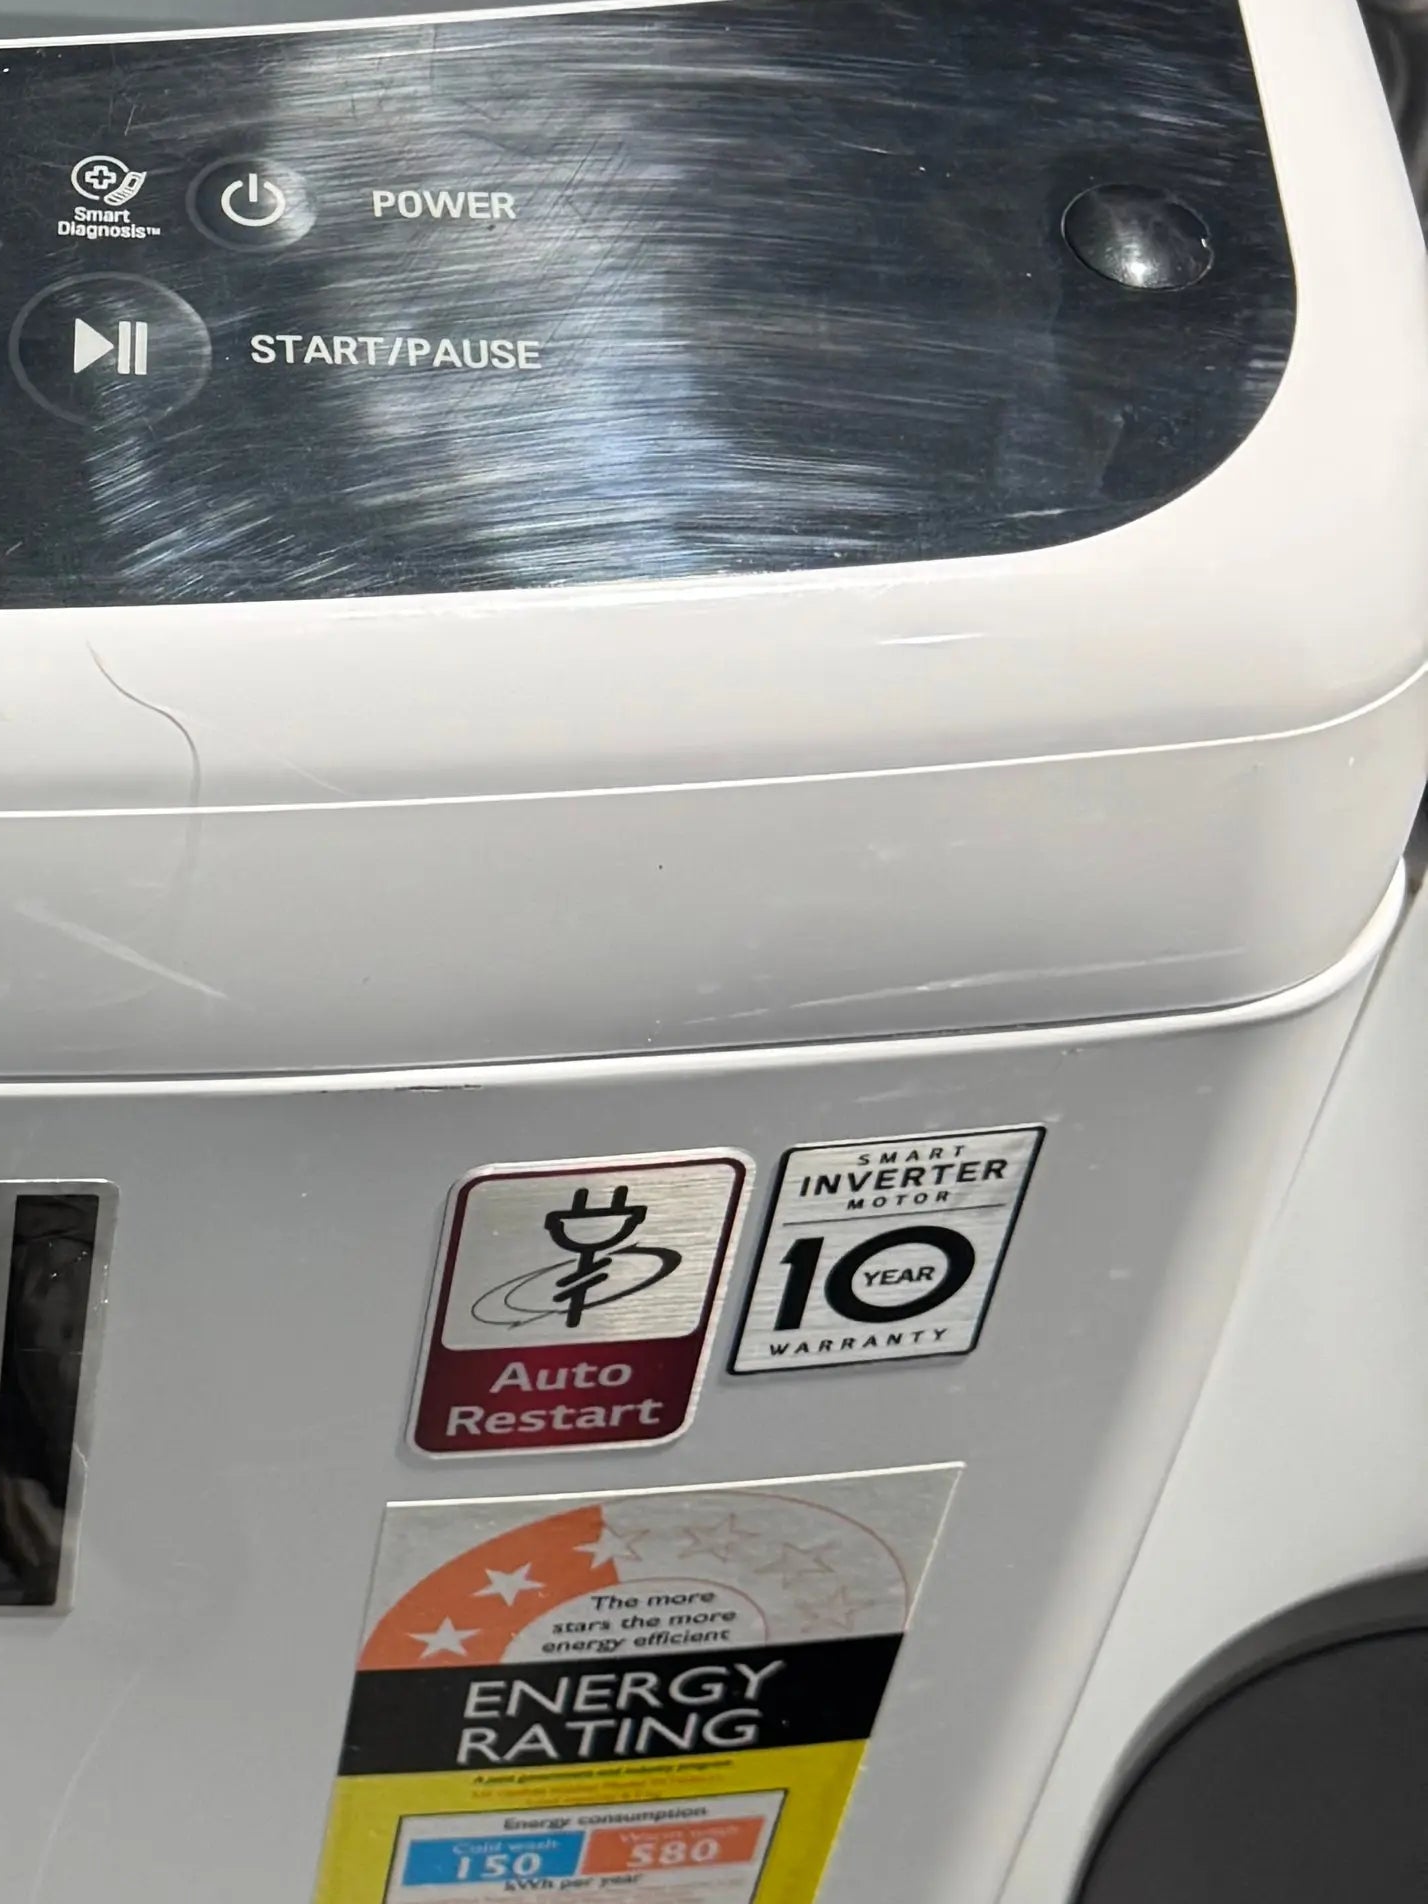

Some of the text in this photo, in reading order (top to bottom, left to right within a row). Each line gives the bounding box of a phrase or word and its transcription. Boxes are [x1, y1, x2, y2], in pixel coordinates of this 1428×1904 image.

[73, 206, 131, 224] Smart
[372, 189, 517, 219] POWER
[250, 334, 543, 370] START/PAUSE
[857, 1145, 966, 1167] SMART
[799, 1158, 1009, 1197] INVERTER
[846, 1190, 951, 1211] MOTOR
[773, 1225, 976, 1331] 10
[862, 1265, 937, 1287] YEAR
[769, 1327, 949, 1357] WARRANTY
[489, 1358, 634, 1395] Auto
[445, 1394, 664, 1437] Restart
[590, 1590, 717, 1612] The more
[552, 1609, 737, 1635] stars the more
[541, 1627, 731, 1655] energy efficient
[463, 1658, 786, 1720] ENERGY
[456, 1707, 764, 1765] RATING
[504, 1805, 708, 1832] Energy consumption
[455, 1851, 542, 1880] 150
[626, 1838, 721, 1869] 580
